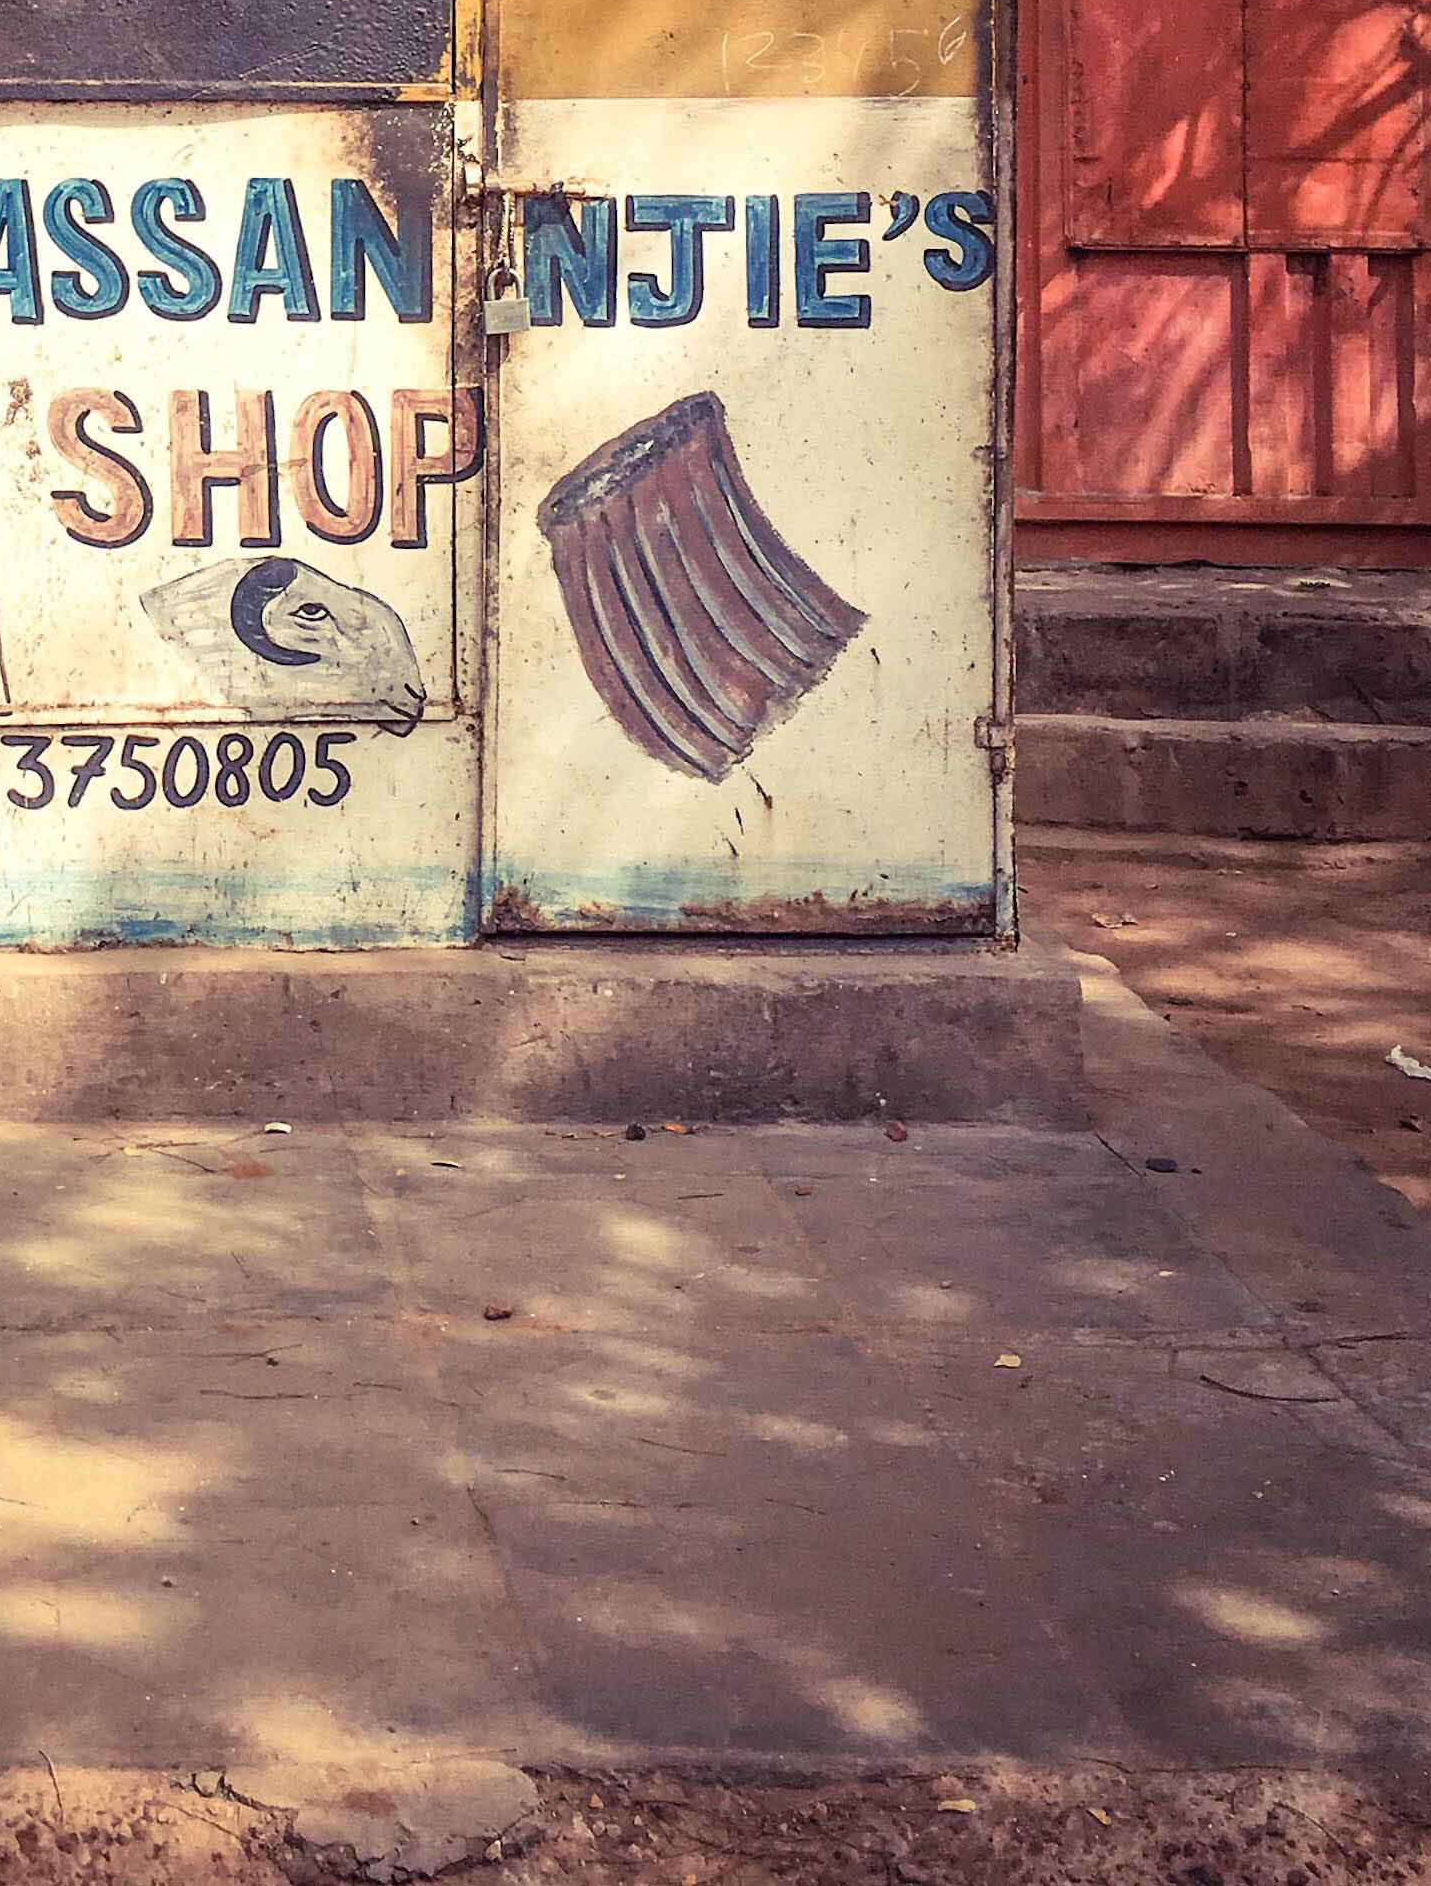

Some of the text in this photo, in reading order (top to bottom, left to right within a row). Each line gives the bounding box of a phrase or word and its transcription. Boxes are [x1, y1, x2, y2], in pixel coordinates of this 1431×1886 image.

[524, 190, 998, 329] NJIE'S
[49, 385, 485, 549] SHOP
[0, 731, 358, 811] 3750805
